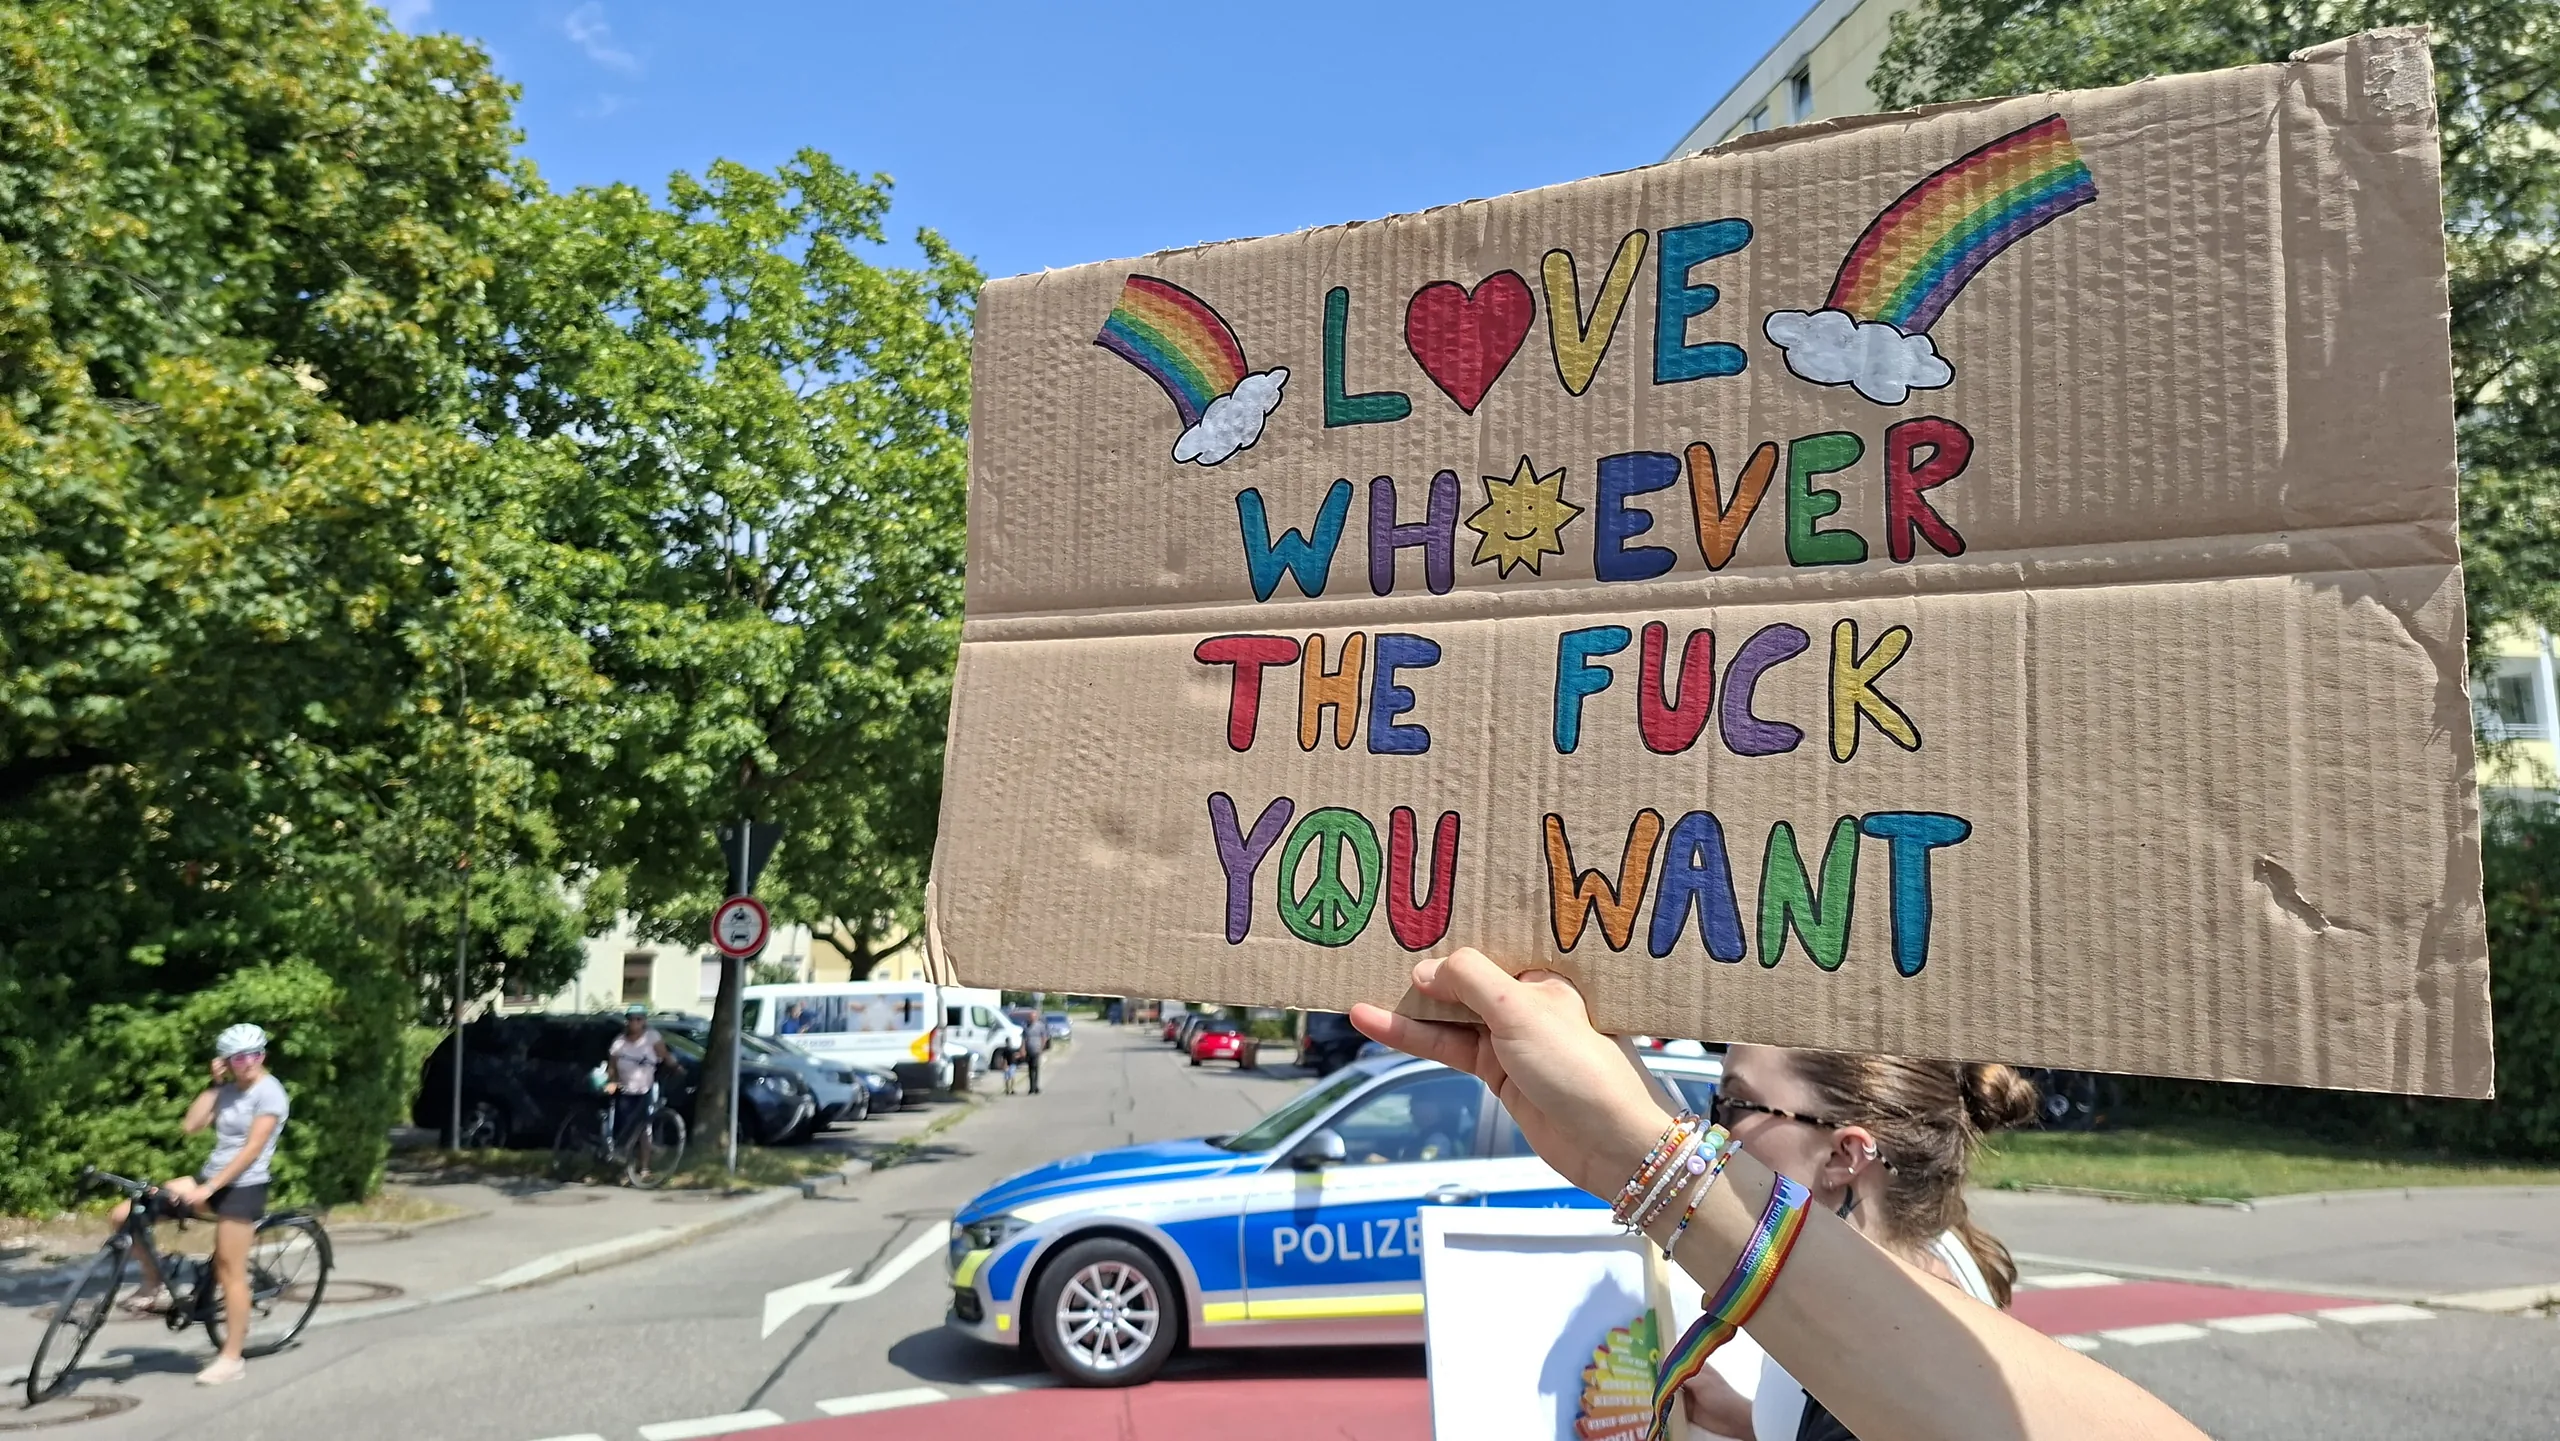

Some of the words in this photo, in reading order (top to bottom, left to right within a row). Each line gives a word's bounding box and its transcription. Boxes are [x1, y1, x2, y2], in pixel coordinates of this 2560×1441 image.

[1194, 631, 1442, 755] THE
[1552, 618, 1922, 763] FUCK
[1207, 791, 1461, 952] YOU
[1543, 808, 1972, 977] WANT
